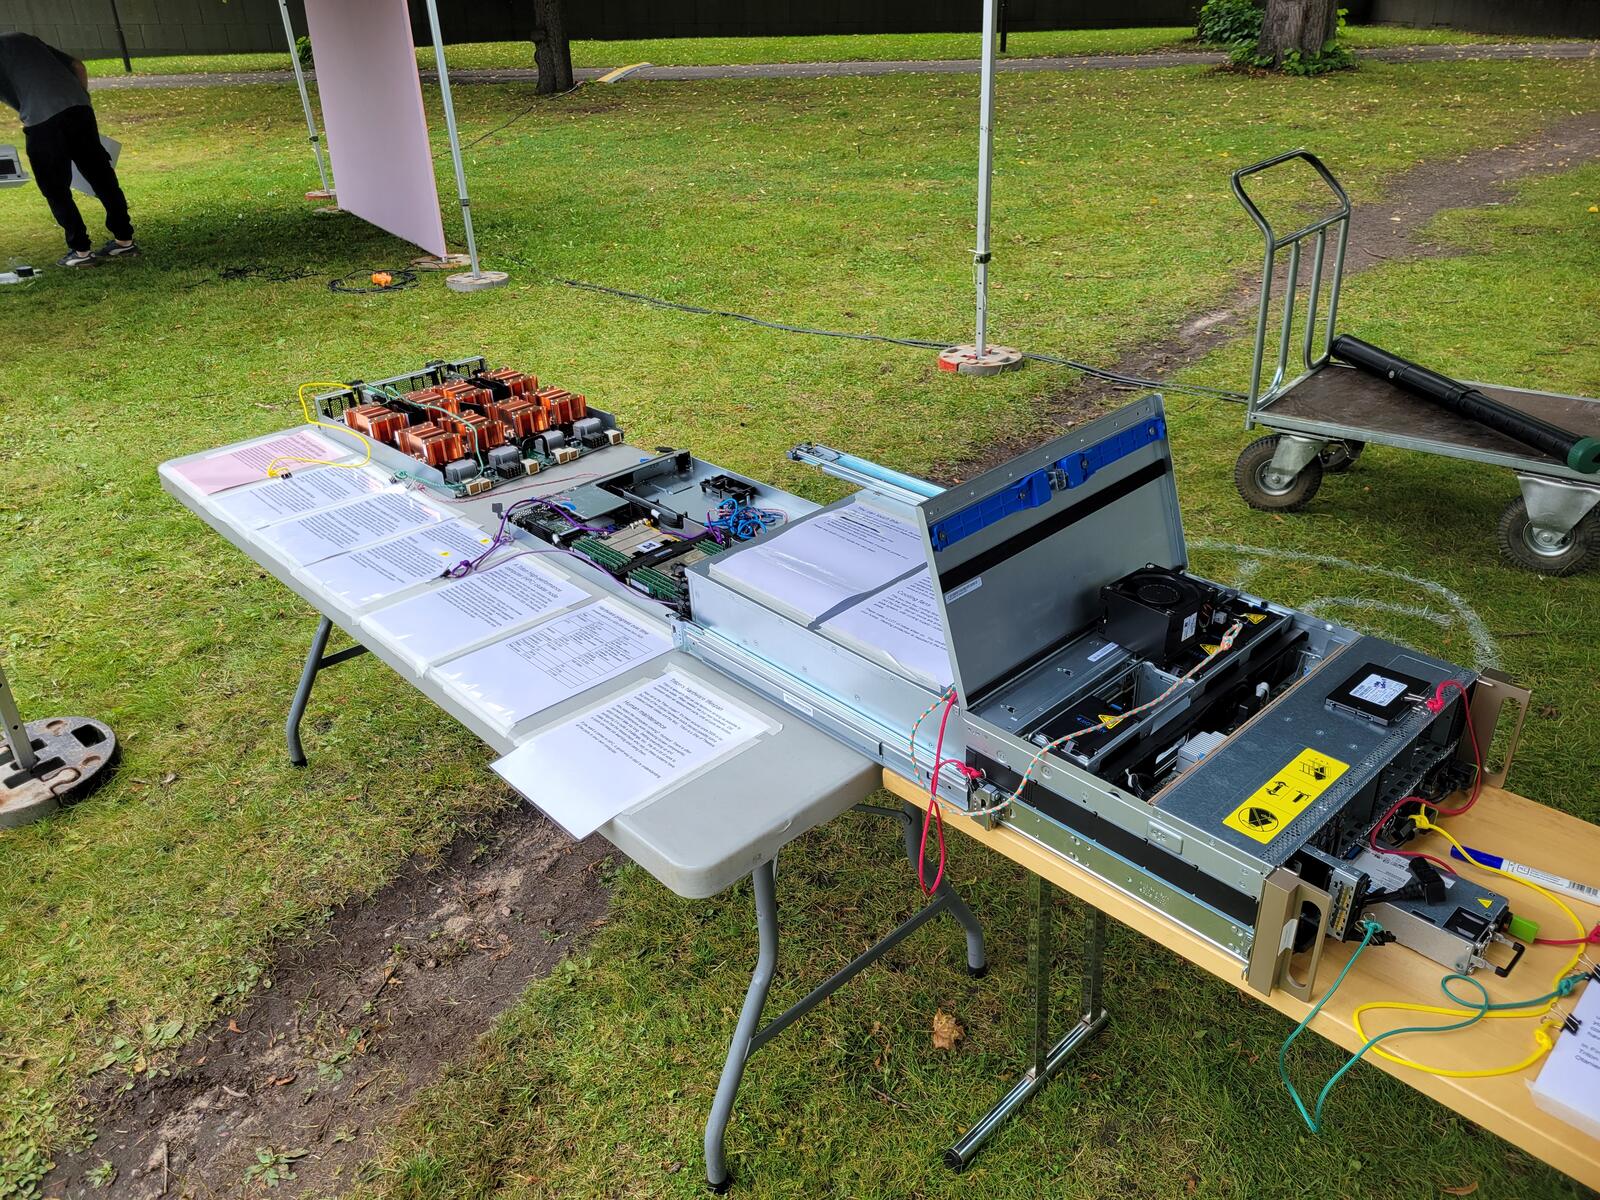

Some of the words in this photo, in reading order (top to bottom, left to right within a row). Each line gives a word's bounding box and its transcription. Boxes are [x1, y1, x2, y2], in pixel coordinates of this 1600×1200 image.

[613, 615, 631, 626] progress
[629, 623, 640, 631] over
[684, 687, 707, 700] hardware
[623, 700, 640, 710] Human
[637, 710, 667, 729] maintenance
